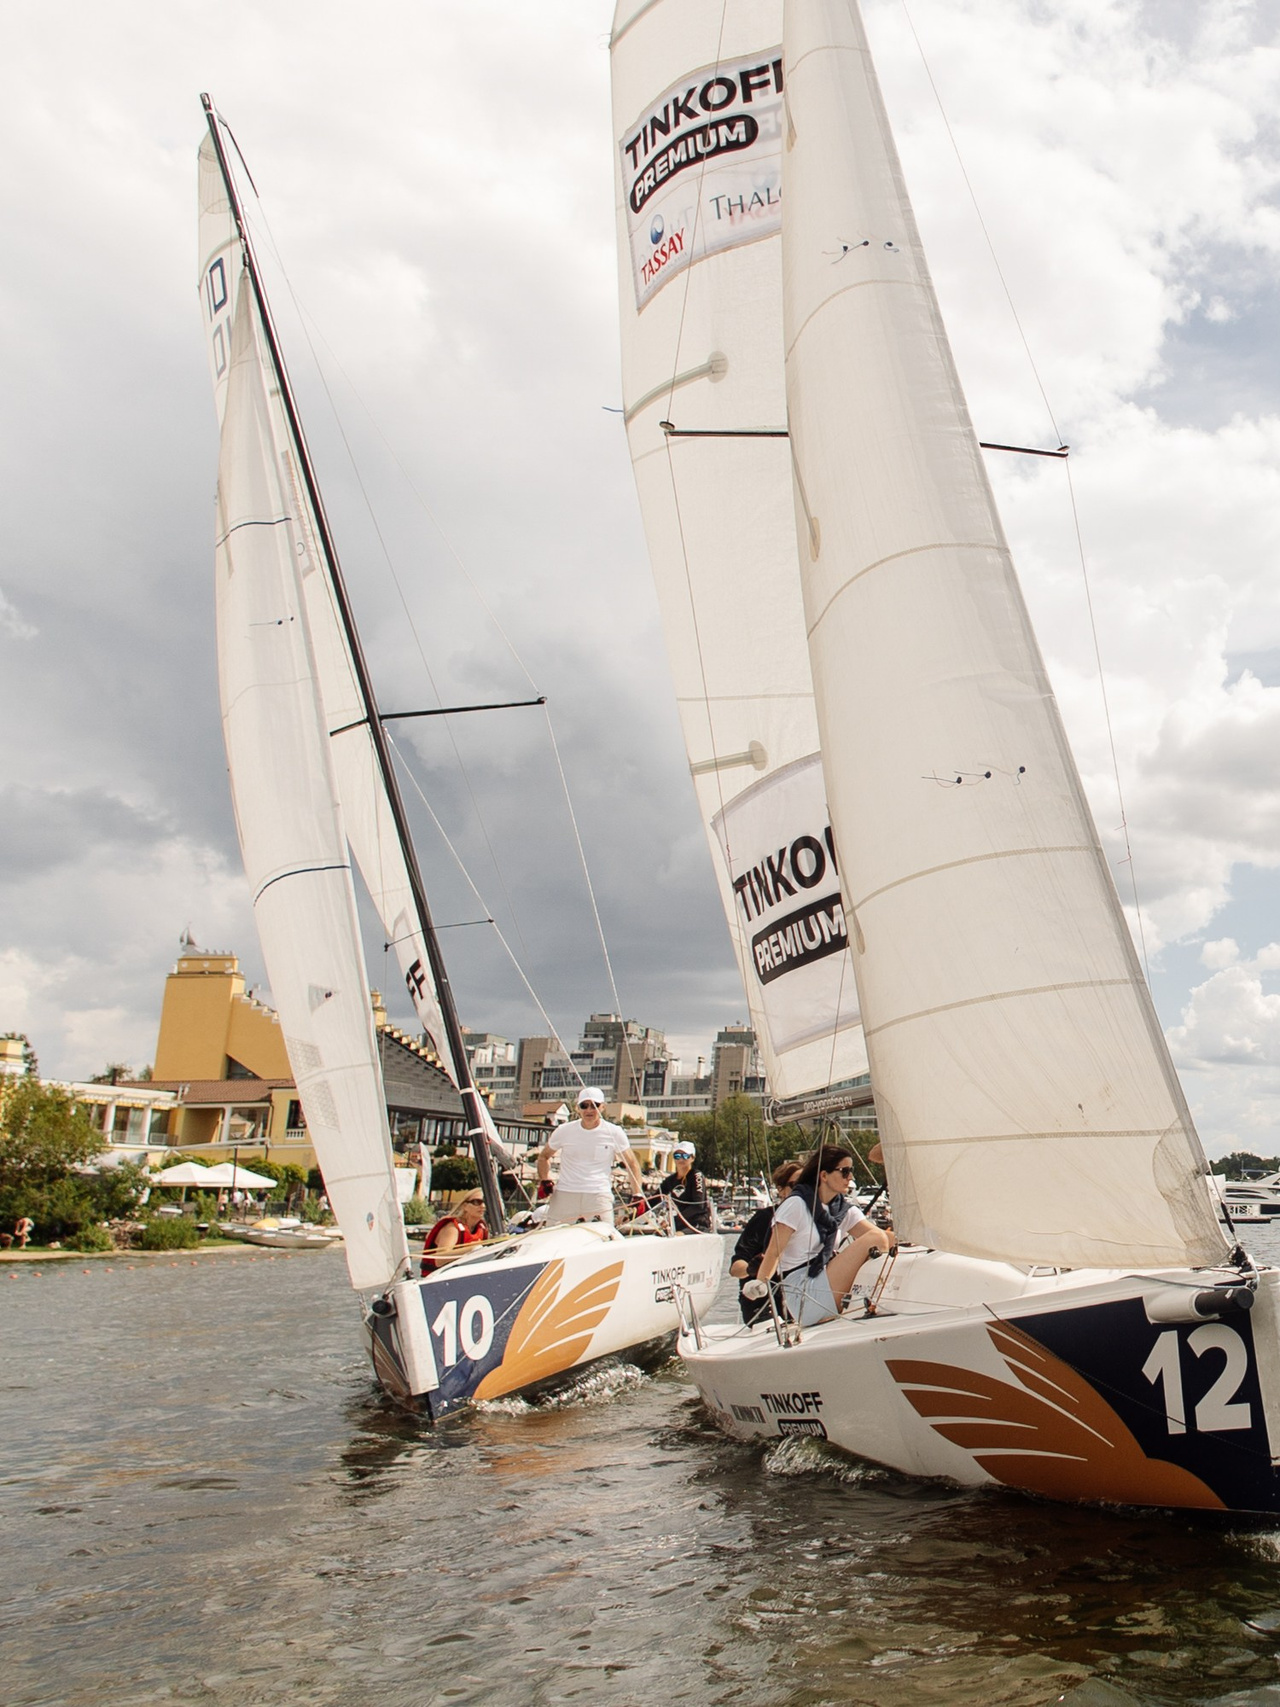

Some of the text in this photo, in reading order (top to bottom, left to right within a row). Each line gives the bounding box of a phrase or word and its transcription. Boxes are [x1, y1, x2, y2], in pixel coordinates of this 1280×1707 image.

[633, 120, 748, 208] PREMIUM
[709, 187, 782, 220] THAL
[640, 227, 686, 286] TASSAY
[754, 903, 848, 976] PREMIUM
[652, 1266, 686, 1284] TINKOFF
[432, 1294, 495, 1368] 10
[760, 1391, 823, 1414] TINKOFF
[1141, 1322, 1252, 1435] 12
